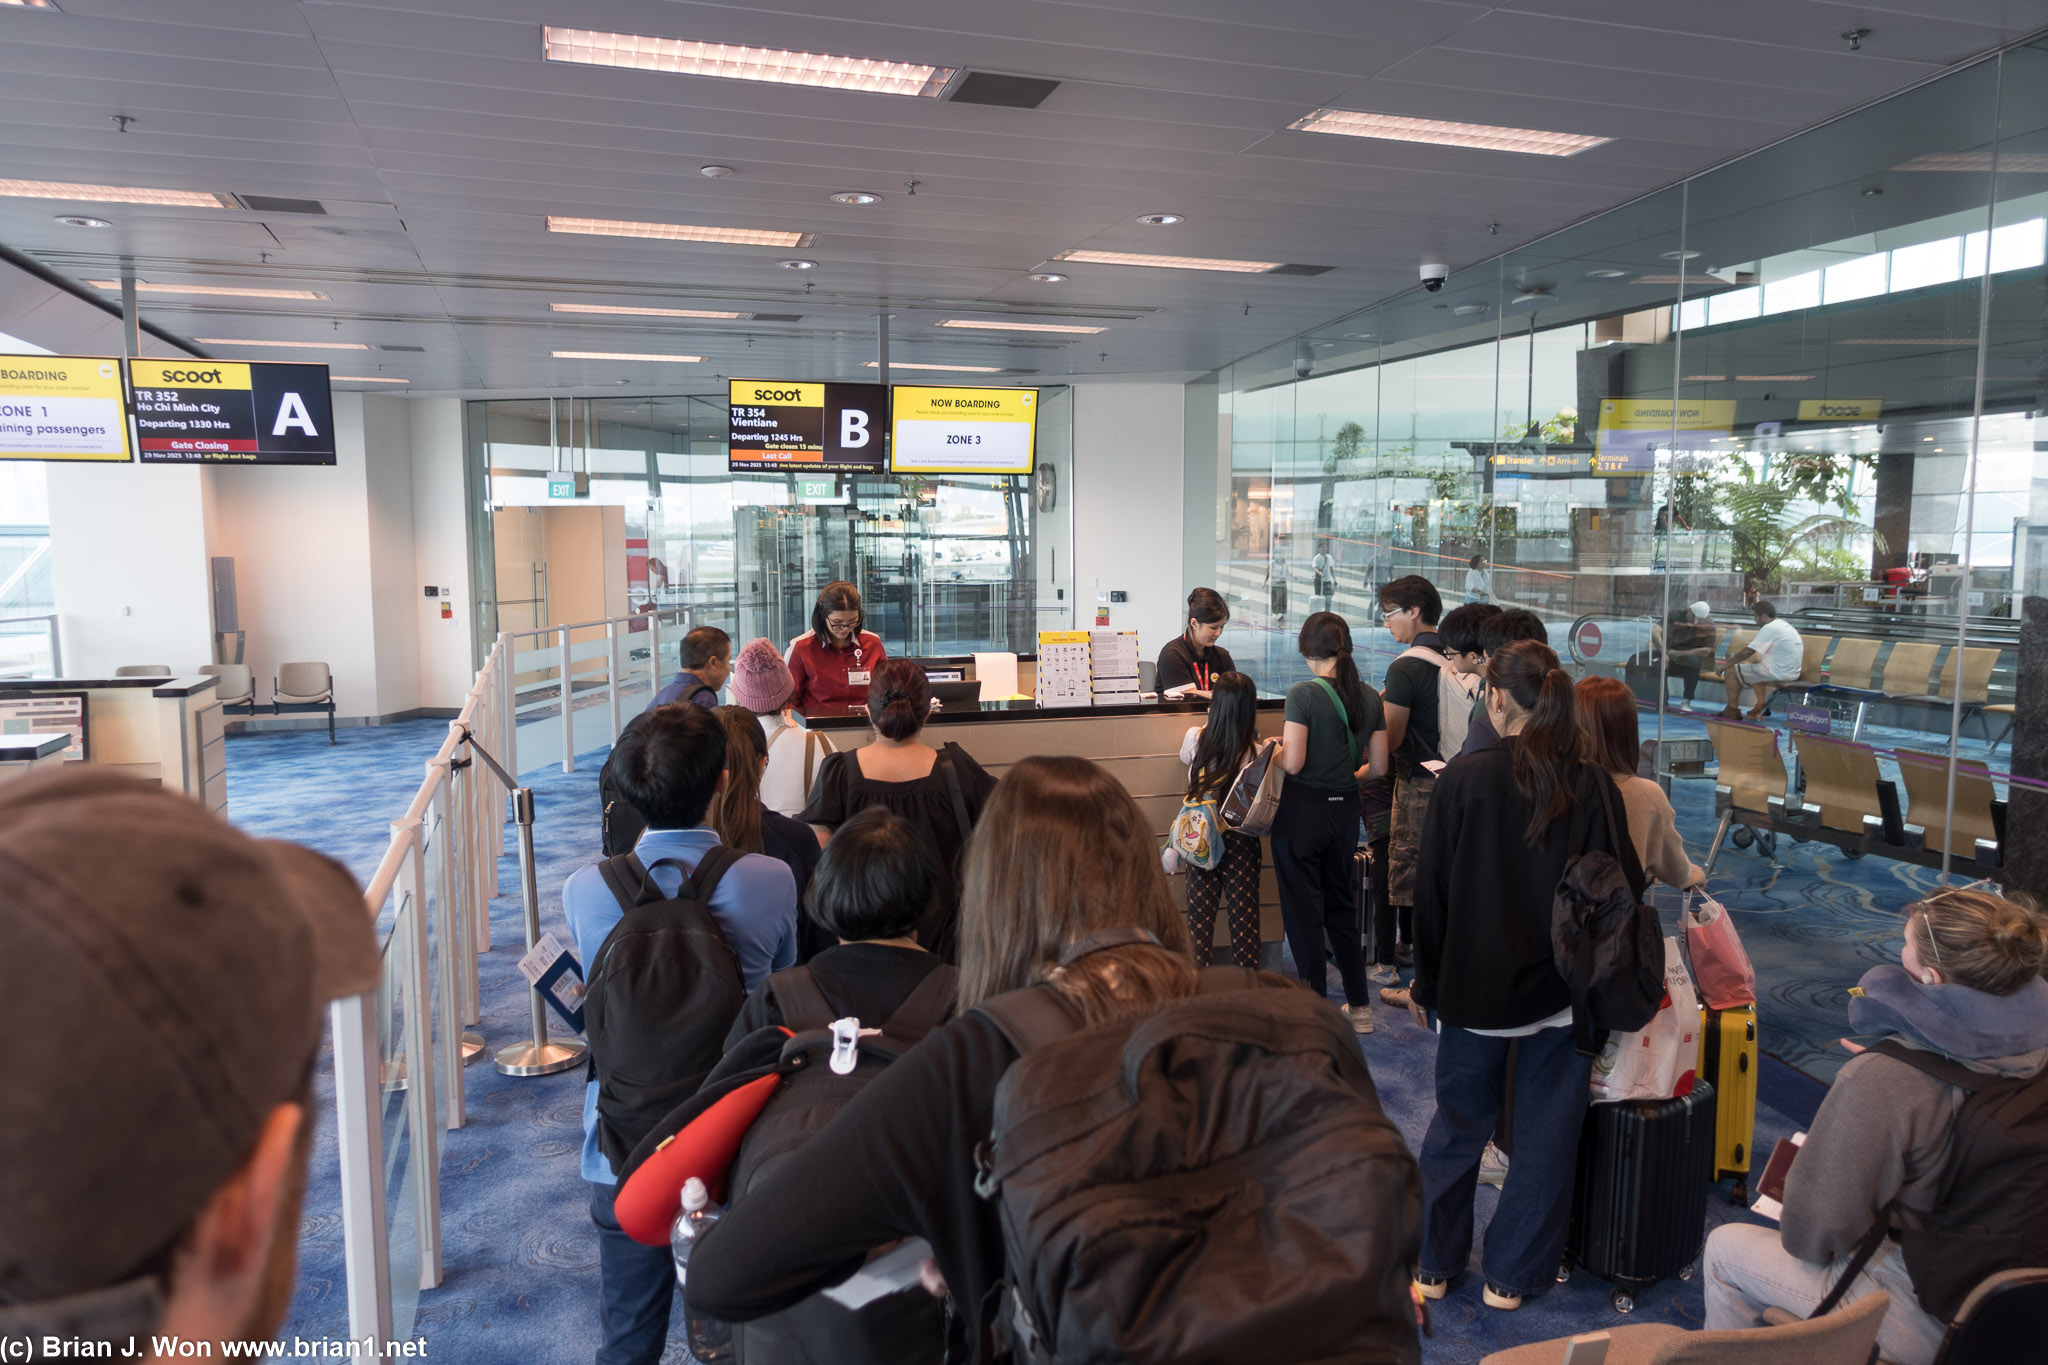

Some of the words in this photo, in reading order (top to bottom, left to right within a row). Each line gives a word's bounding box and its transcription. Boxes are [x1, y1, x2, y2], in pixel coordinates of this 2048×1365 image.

[1, 370, 68, 381] BOARDING
[162, 369, 222, 384] scoot
[135, 391, 153, 401] TR
[156, 391, 179, 402] 352
[754, 389, 801, 402] scoot
[137, 403, 153, 411] Ho
[154, 403, 170, 411] Chi
[173, 404, 199, 412] Minh
[201, 404, 220, 414] City
[931, 399, 953, 408] NOW
[955, 399, 1000, 409] BOARDING
[41, 406, 48, 417] 1
[271, 392, 319, 437] A
[731, 407, 745, 417] TR
[747, 408, 766, 418] 354
[139, 419, 187, 430] Departing
[189, 420, 212, 429] 1330
[214, 421, 231, 429] Hrs
[731, 417, 778, 428] Vientiane
[37, 425, 106, 437] passengers
[840, 409, 870, 448] B
[731, 433, 769, 442] Departing
[770, 433, 789, 441] 1245
[790, 434, 803, 442] Hrs
[947, 435, 973, 445] ZONE
[975, 435, 981, 445] 3
[171, 441, 193, 449] Gate
[194, 442, 229, 451] Closing
[762, 452, 777, 460] Last
[778, 452, 792, 460] Call
[1507, 456, 1534, 465] Transfer
[1556, 456, 1579, 465] Arrival
[553, 484, 570, 496] EXIT
[805, 484, 827, 496] EXIT
